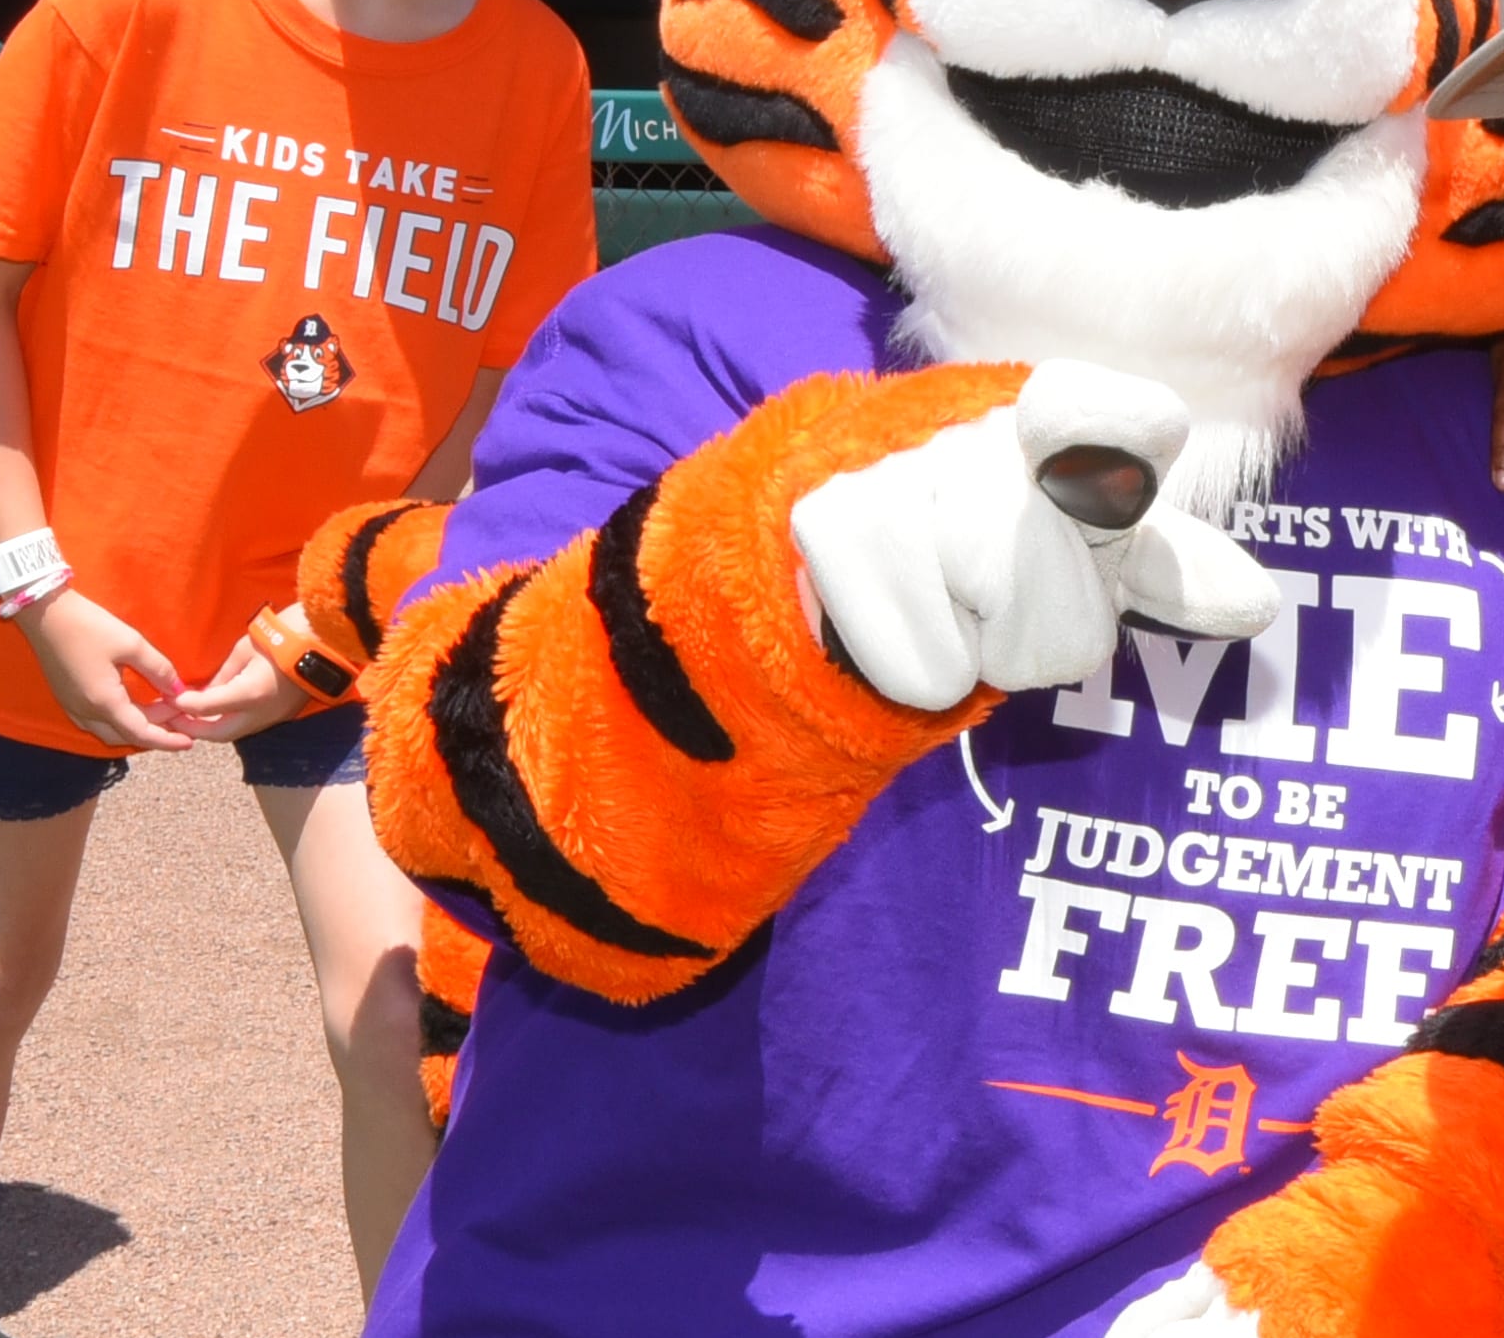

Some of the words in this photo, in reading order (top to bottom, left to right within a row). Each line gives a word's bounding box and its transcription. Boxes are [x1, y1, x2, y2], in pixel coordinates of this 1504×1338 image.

[220, 124, 326, 177] KIDS
[344, 148, 458, 203] TAKE
[108, 158, 280, 283] THE
[303, 194, 516, 332] FIELD
[1228, 500, 1331, 549] RTS
[1340, 506, 1473, 567] WITH
[1051, 568, 1482, 781] ME
[1184, 768, 1263, 820] TO
[1273, 779, 1347, 831] BE
[1023, 806, 1463, 912] JUDGEMENT
[997, 872, 1456, 1048] FREE
[1149, 1049, 1258, 1178] D
